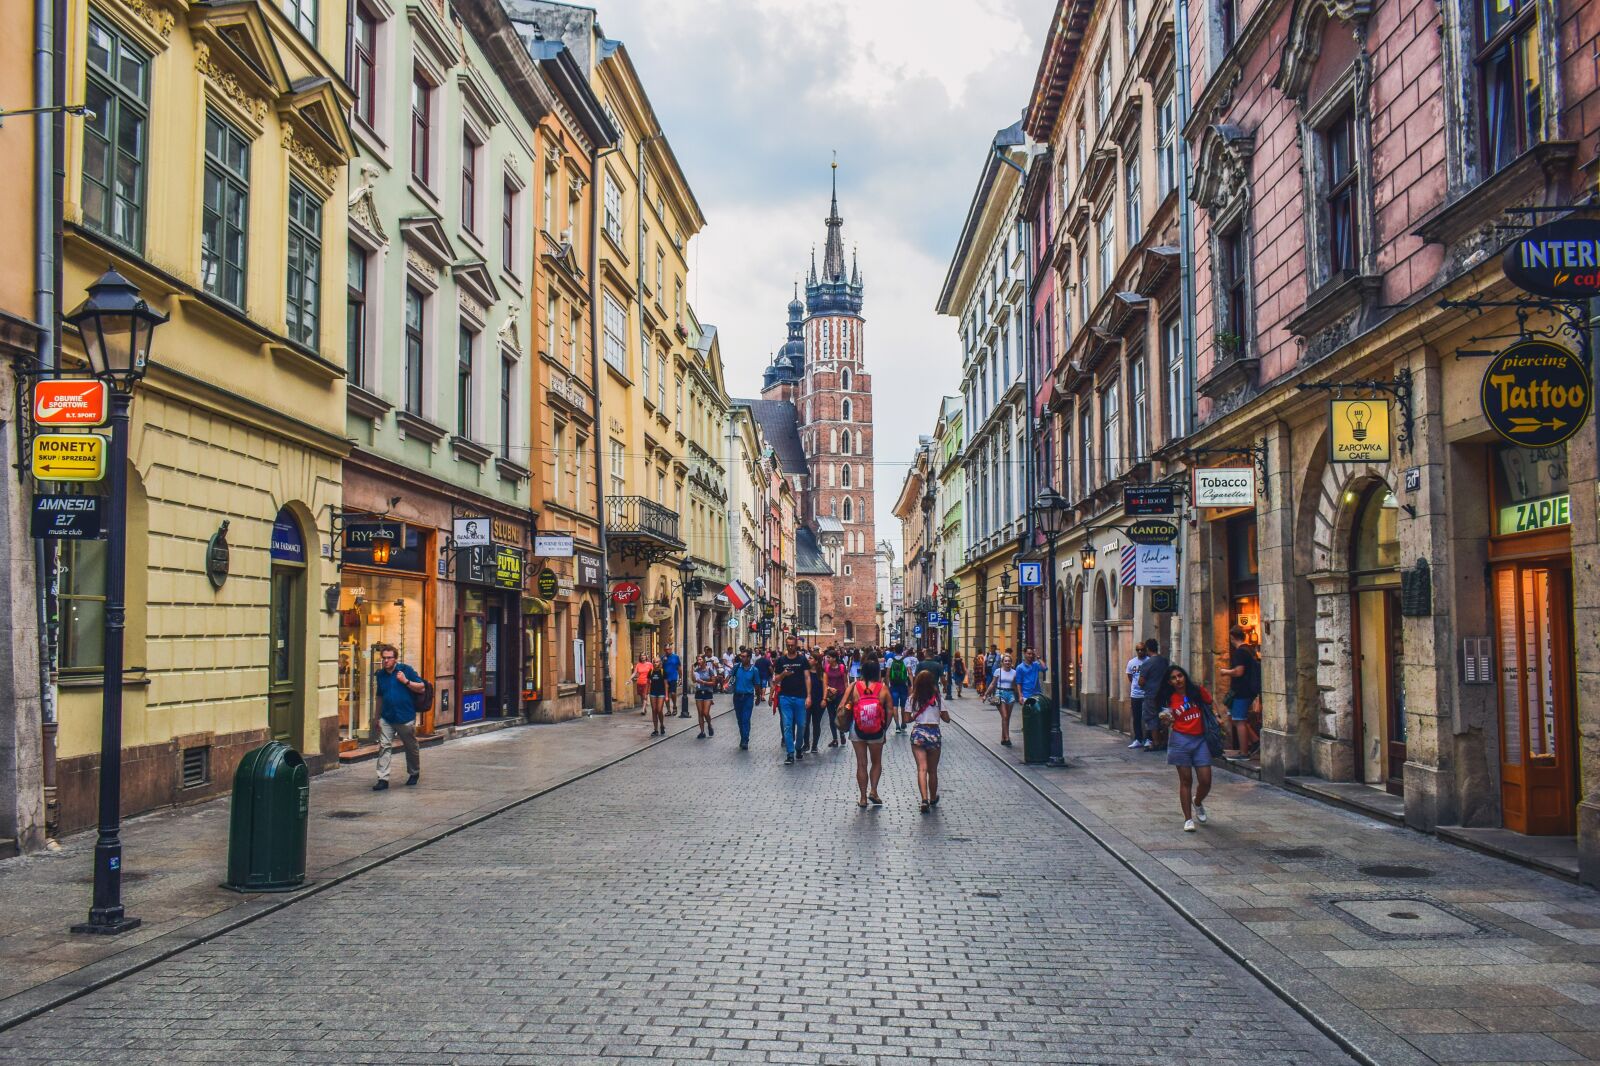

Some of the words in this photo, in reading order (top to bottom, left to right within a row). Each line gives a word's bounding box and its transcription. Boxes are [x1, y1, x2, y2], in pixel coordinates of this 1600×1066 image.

[1521, 240, 1600, 268] INTER
[1502, 354, 1567, 370] piercing
[1490, 374, 1585, 413] Tattoo
[39, 441, 96, 452] MONETY
[1348, 452, 1371, 460] CAFE
[1201, 477, 1248, 488] Tobacco
[1202, 489, 1247, 501] Cigarettes
[38, 499, 96, 511] AMNESIA
[1516, 497, 1569, 532] ZAPIE
[1130, 526, 1175, 535] KANTOR
